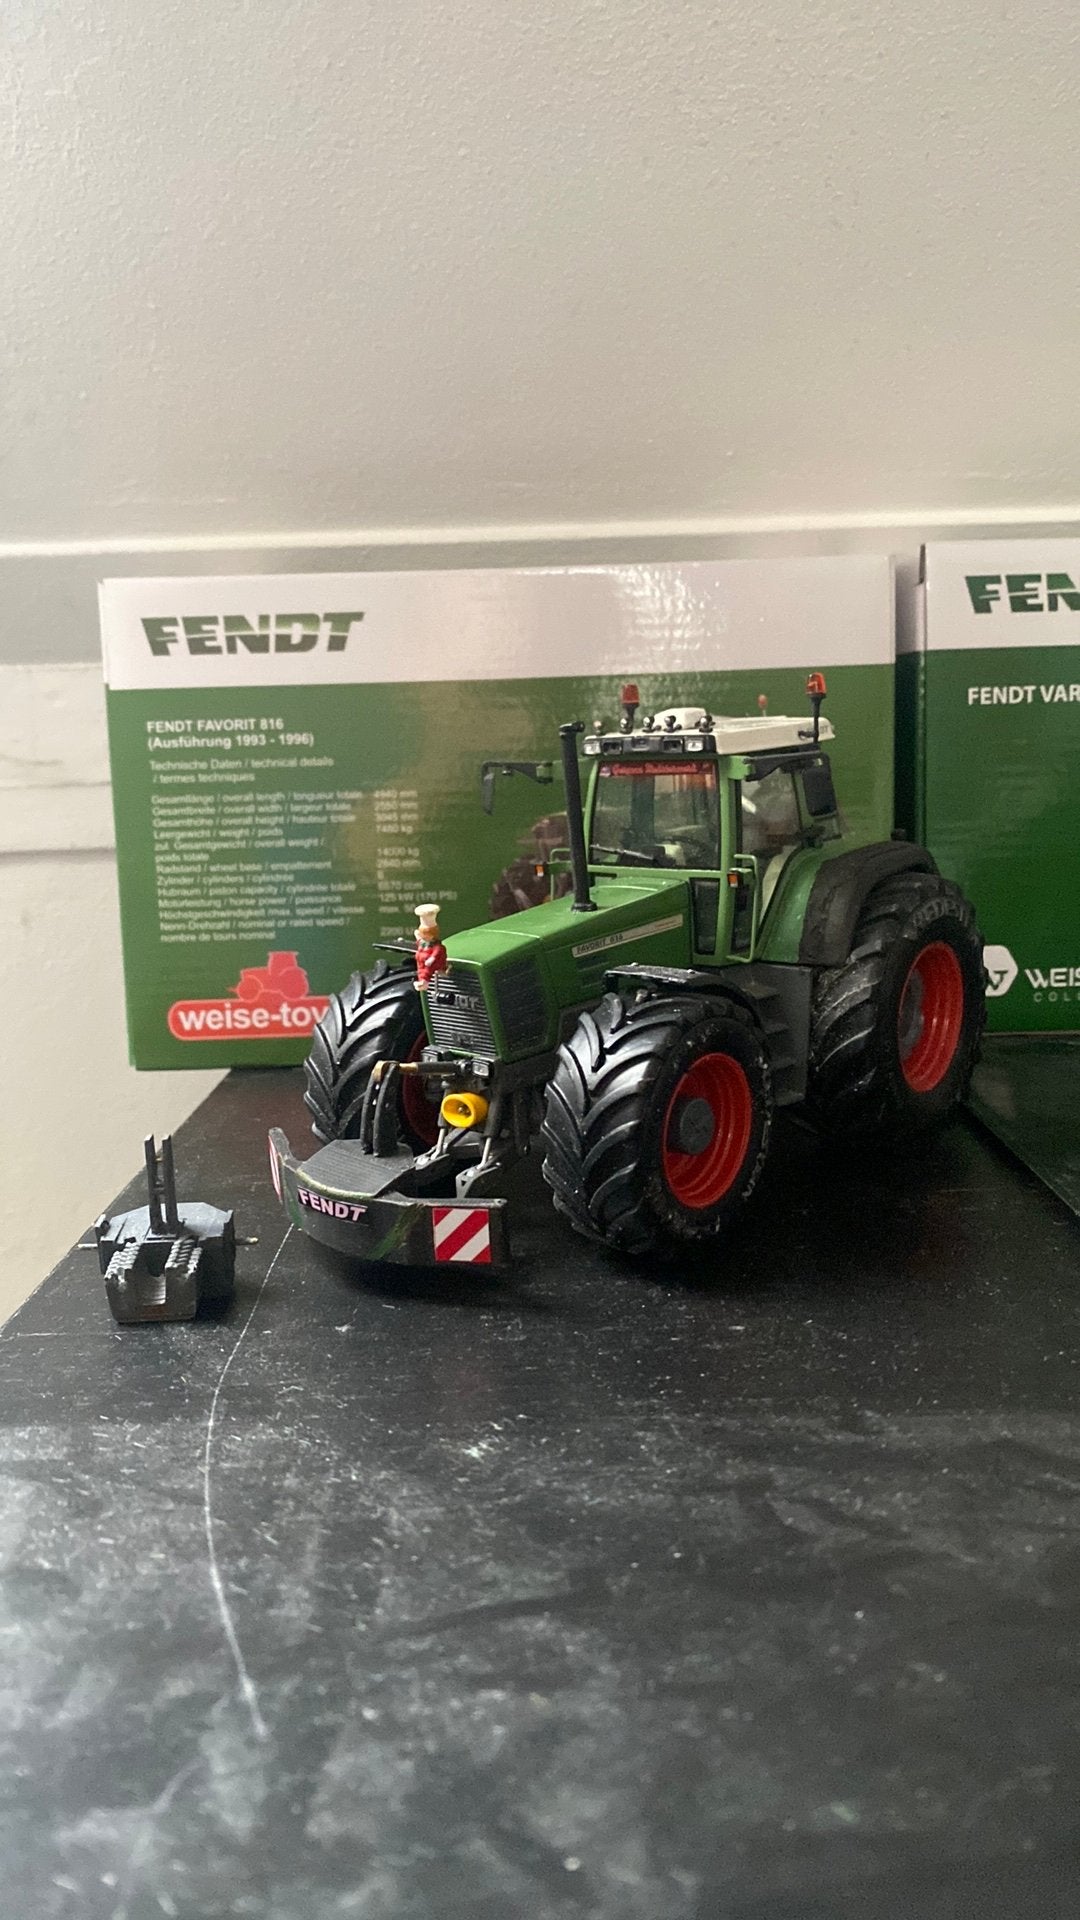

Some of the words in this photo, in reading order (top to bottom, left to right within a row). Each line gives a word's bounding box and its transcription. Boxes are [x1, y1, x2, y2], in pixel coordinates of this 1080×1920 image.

[964, 573, 1080, 614] FEN
[140, 611, 365, 656] FENDT
[967, 685, 1037, 705] FENDT
[1040, 684, 1080, 703] VAR
[147, 720, 193, 733] FENDT
[197, 719, 257, 732] FAVORIT
[260, 718, 285, 730] 816
[148, 735, 231, 750] (Ausführung
[236, 734, 266, 746] 1993
[279, 732, 314, 748] 1996)
[149, 760, 208, 771] Technische
[210, 759, 242, 769] Daten
[251, 757, 298, 769] technical
[300, 756, 335, 767] details
[159, 773, 196, 784] termes
[198, 772, 256, 784] techniques
[1024, 967, 1080, 989] WEI
[1033, 991, 1080, 1002] COL
[178, 1001, 330, 1032] weise-toy
[300, 1189, 367, 1222] FENDT
